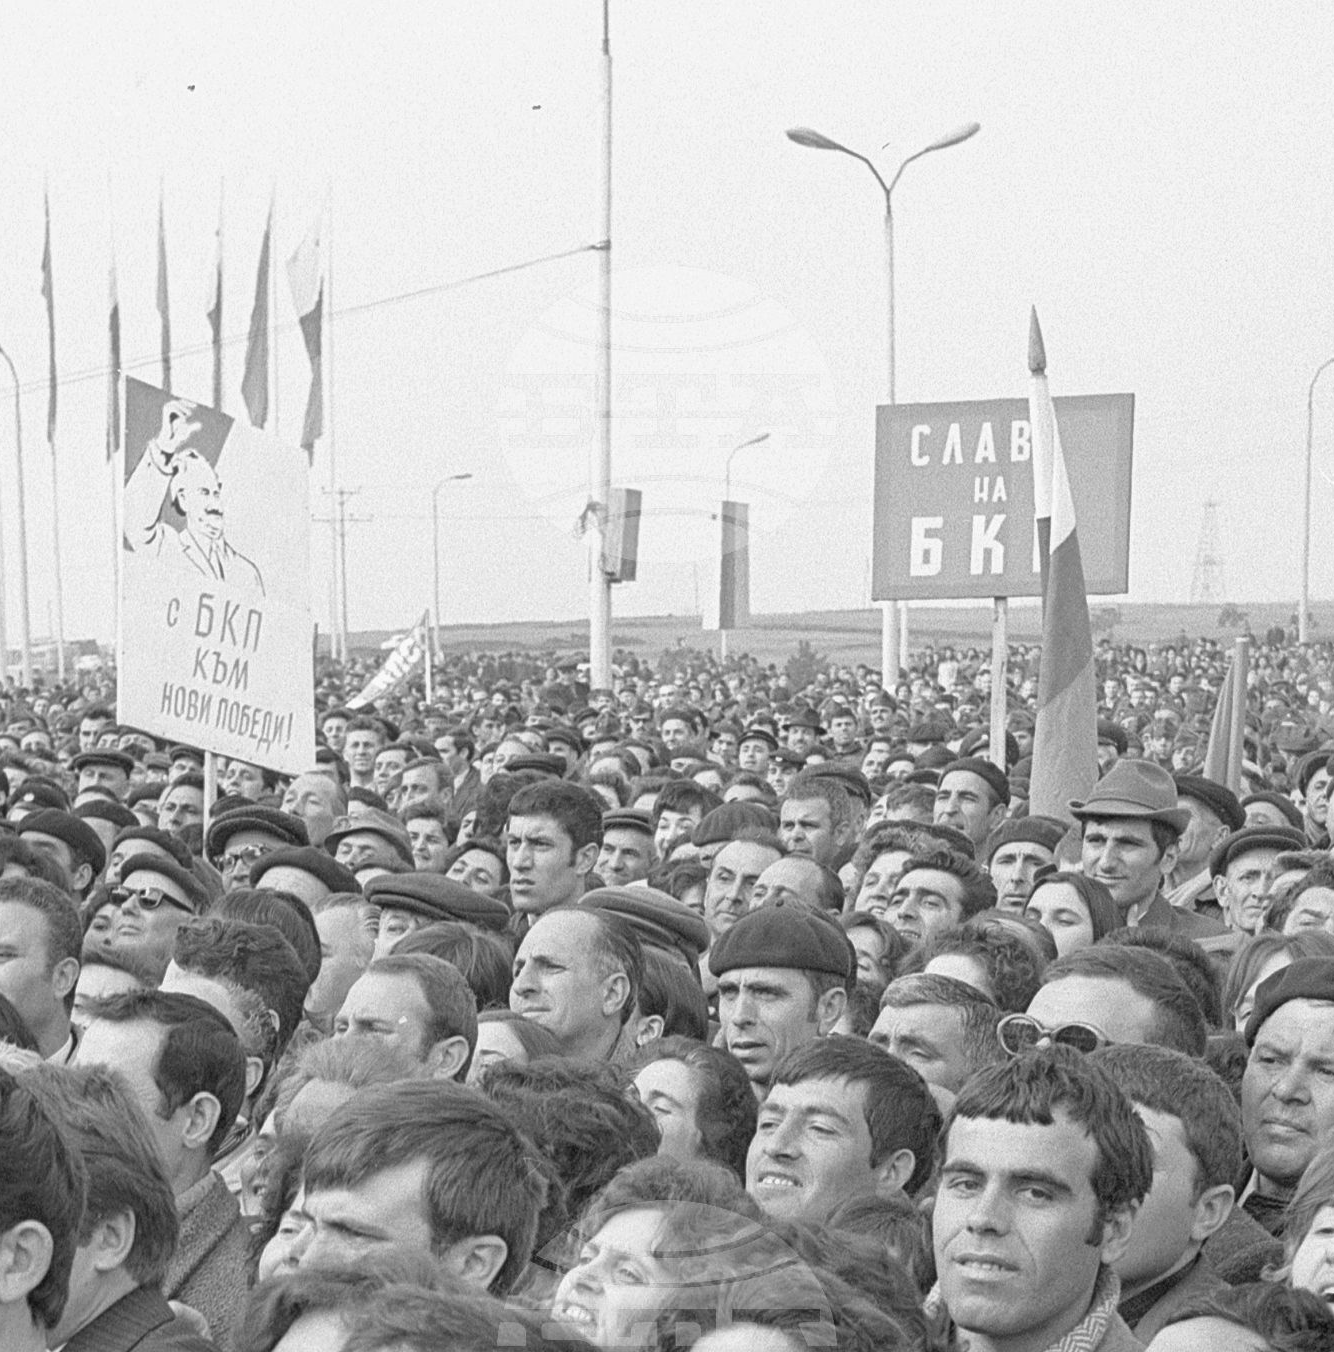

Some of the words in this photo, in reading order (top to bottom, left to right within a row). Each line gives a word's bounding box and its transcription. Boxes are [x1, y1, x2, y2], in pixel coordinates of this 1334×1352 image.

[910, 419, 1032, 467] СЛАВ
[973, 474, 1008, 504] НА
[909, 513, 1042, 578] БК
[194, 592, 263, 653] БКП
[192, 646, 249, 692] КЪМ
[160, 681, 214, 726] НОВИ
[215, 697, 294, 754] ПОБЕДИ!
